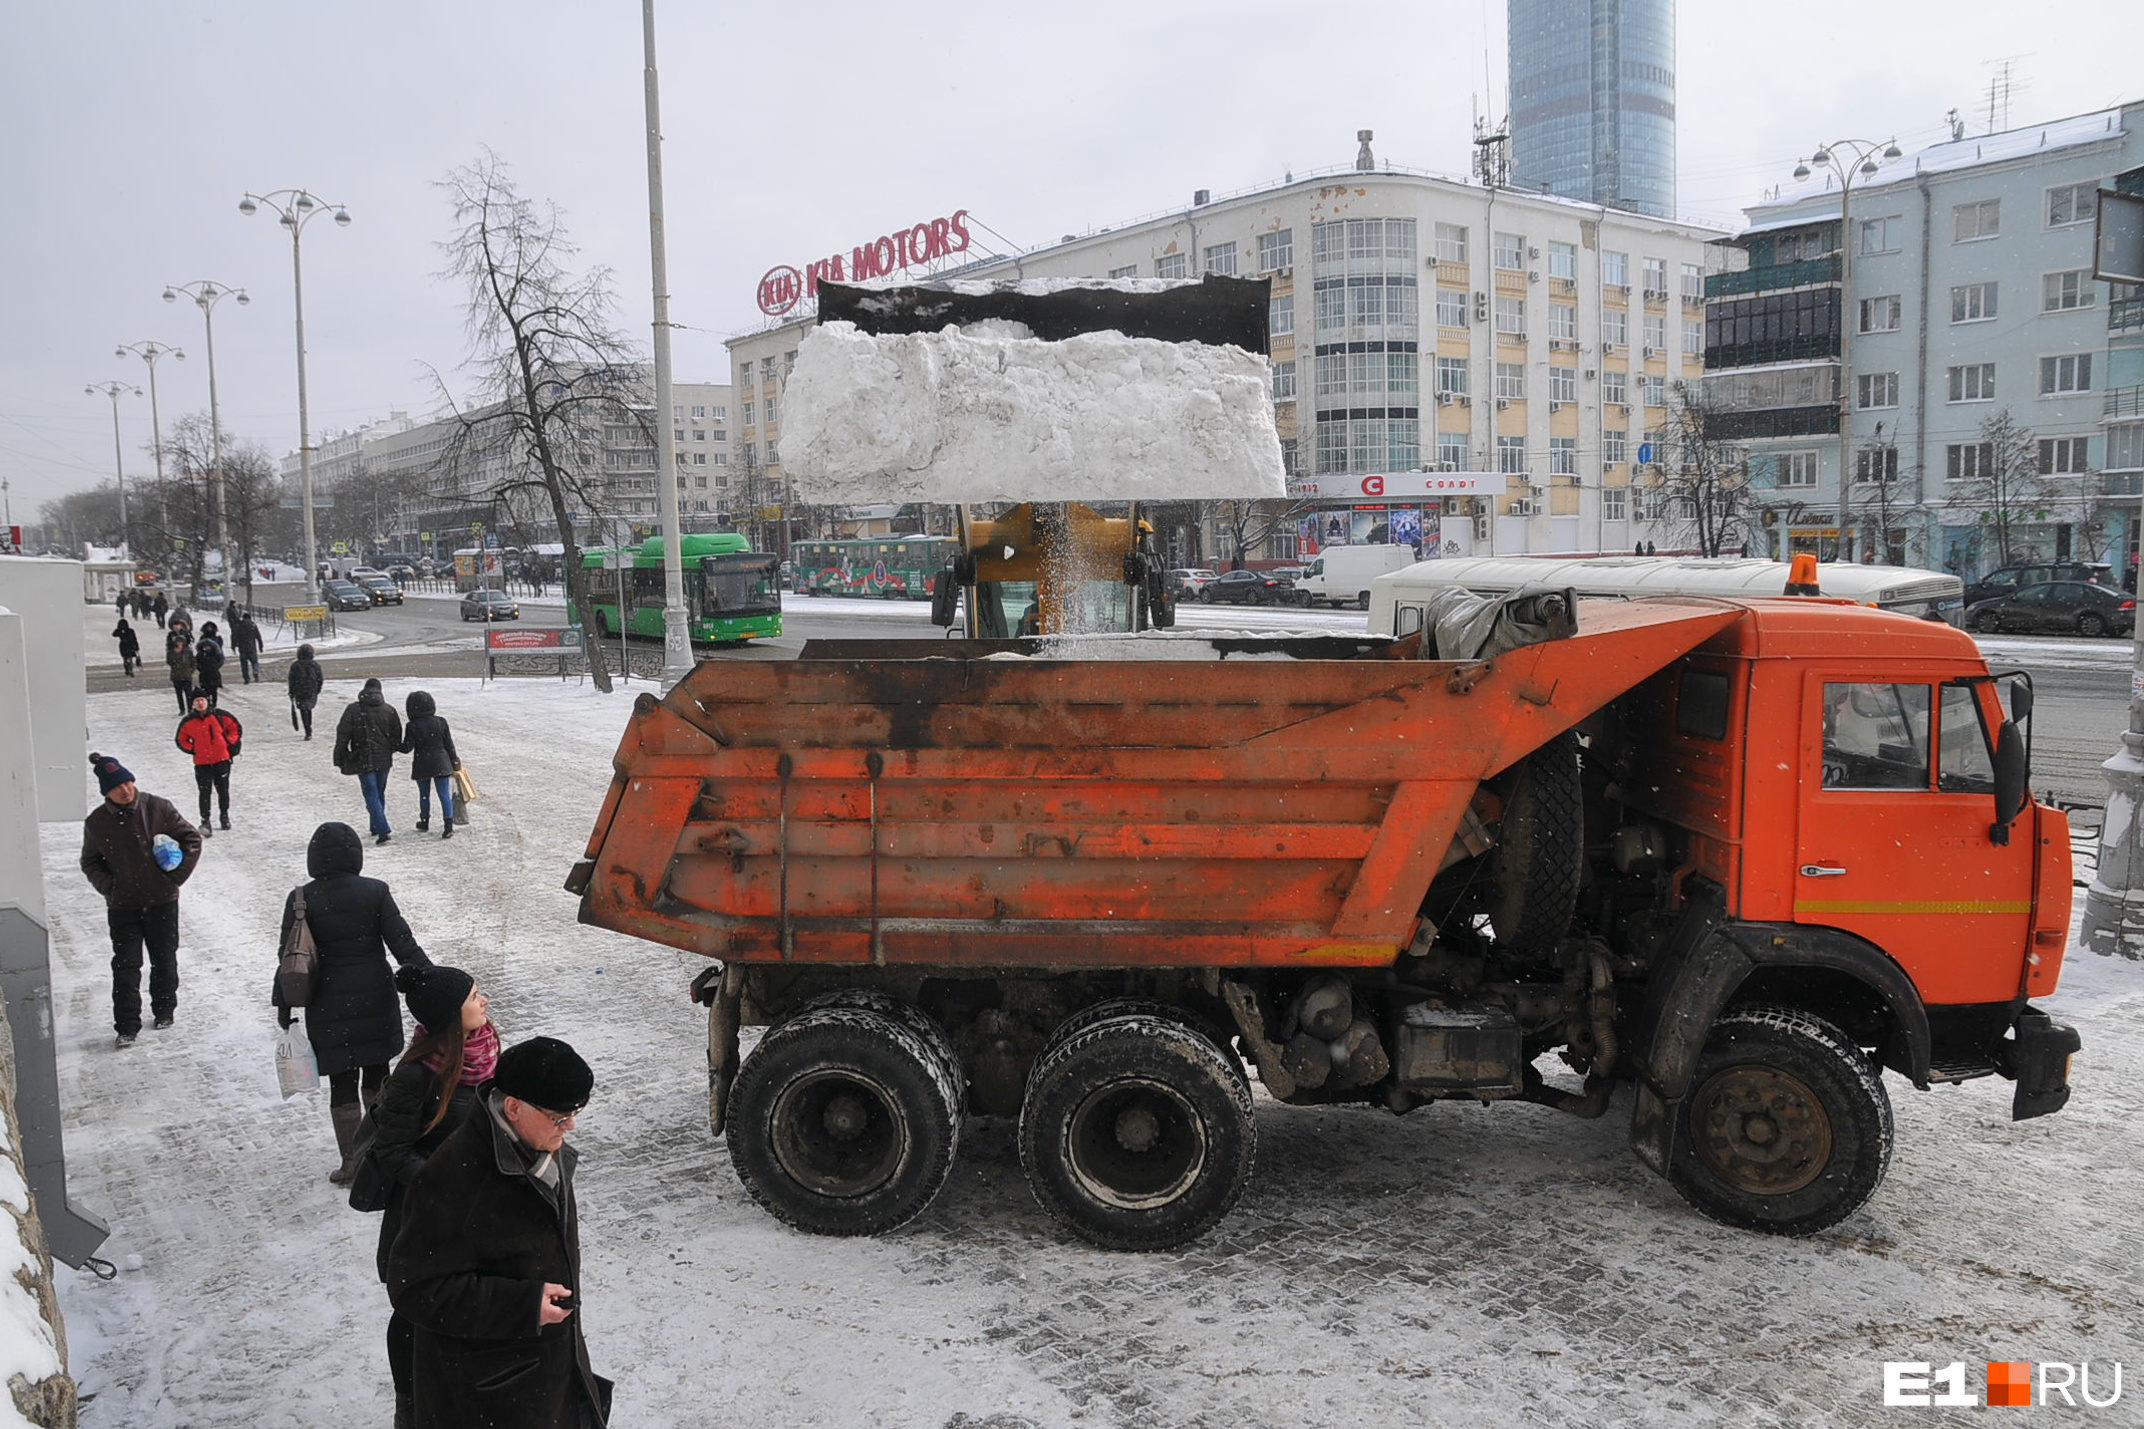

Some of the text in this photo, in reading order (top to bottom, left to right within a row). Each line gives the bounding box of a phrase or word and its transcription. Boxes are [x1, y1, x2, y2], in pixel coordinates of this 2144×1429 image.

[806, 209, 970, 297] KIA MOTORS
[764, 274, 795, 307] KIA
